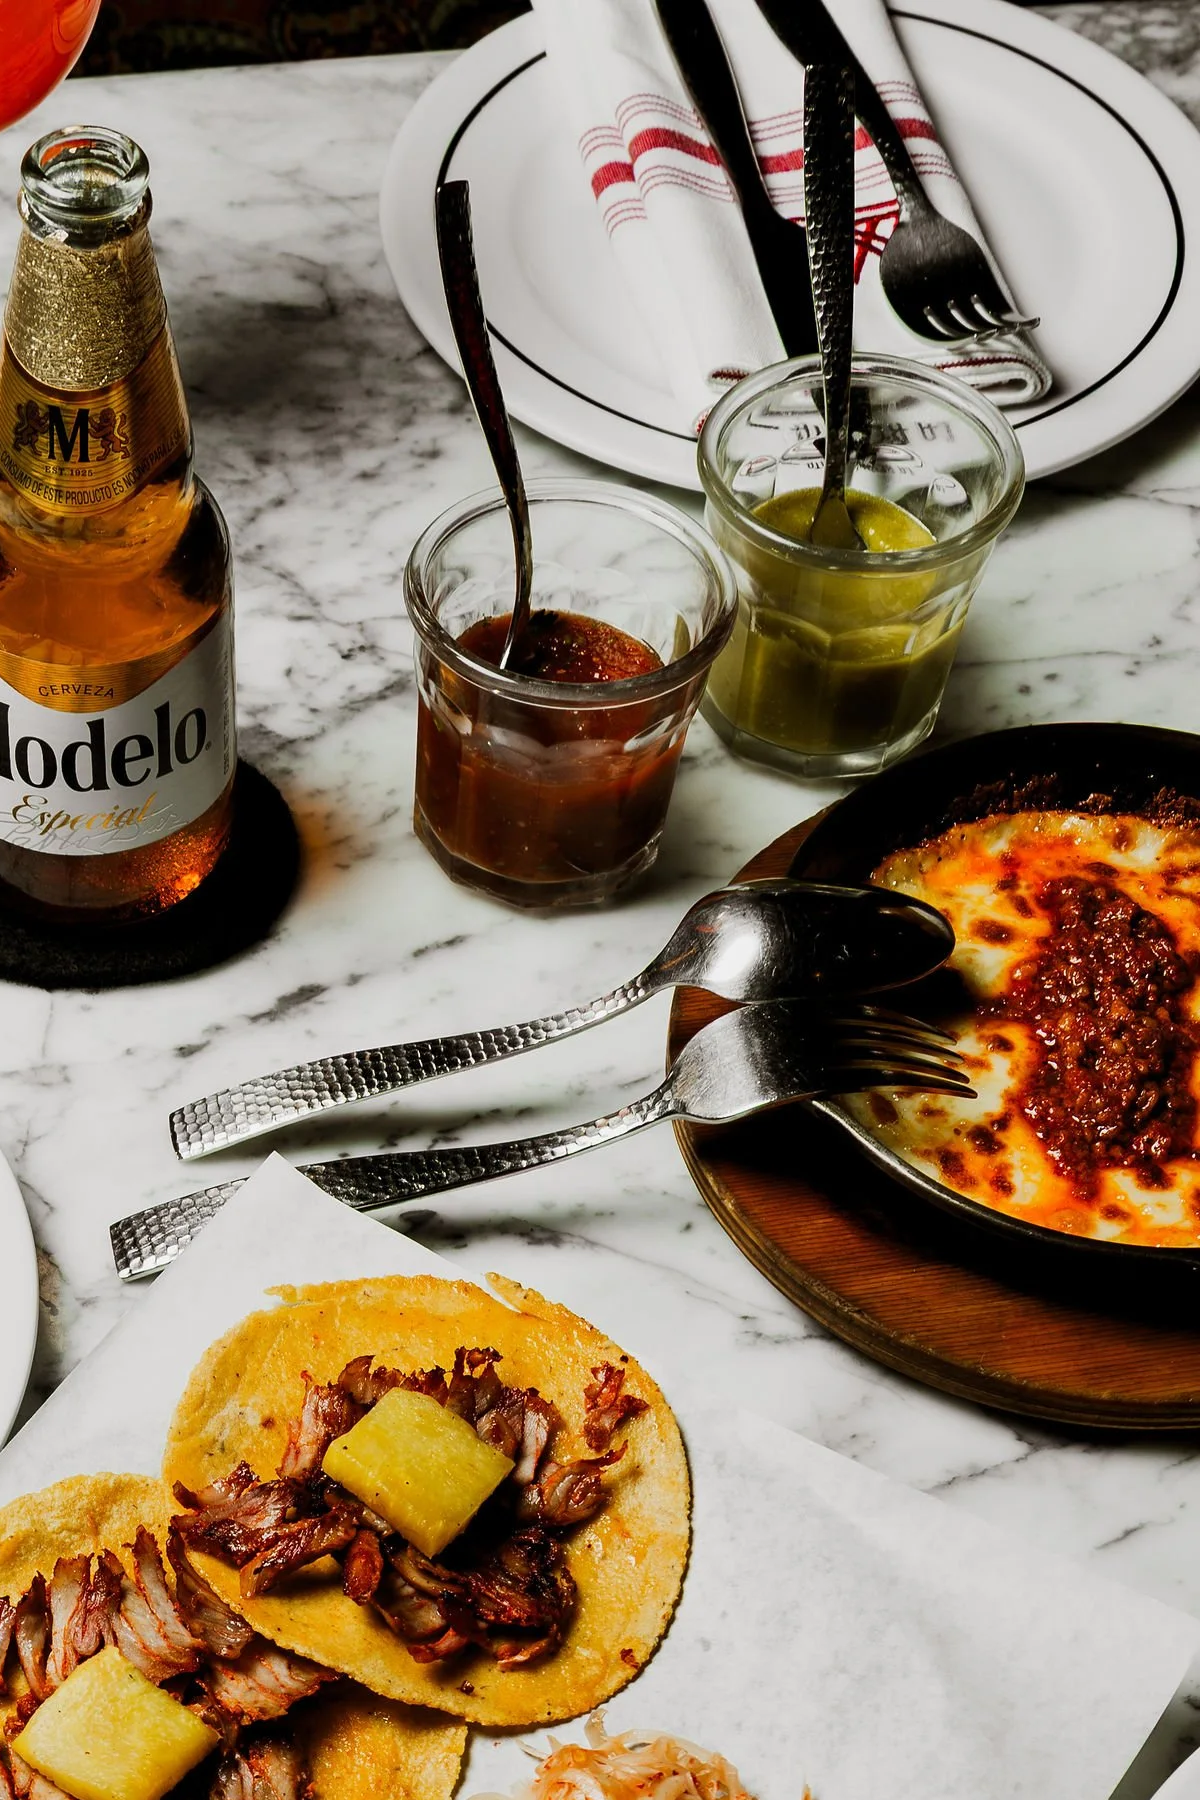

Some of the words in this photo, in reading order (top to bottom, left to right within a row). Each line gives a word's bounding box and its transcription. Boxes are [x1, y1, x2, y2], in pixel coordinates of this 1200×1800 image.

[47, 404, 91, 463] M
[0, 448, 32, 490] CONSUMO
[31, 479, 43, 497] DE
[43, 485, 64, 504] ESTE
[65, 485, 113, 505] PRODUCTO
[111, 480, 125, 496] ES
[44, 465, 68, 476] EST.
[70, 468, 94, 478] 1925
[38, 683, 115, 699] CERVEZA
[11, 791, 158, 836] Especial
